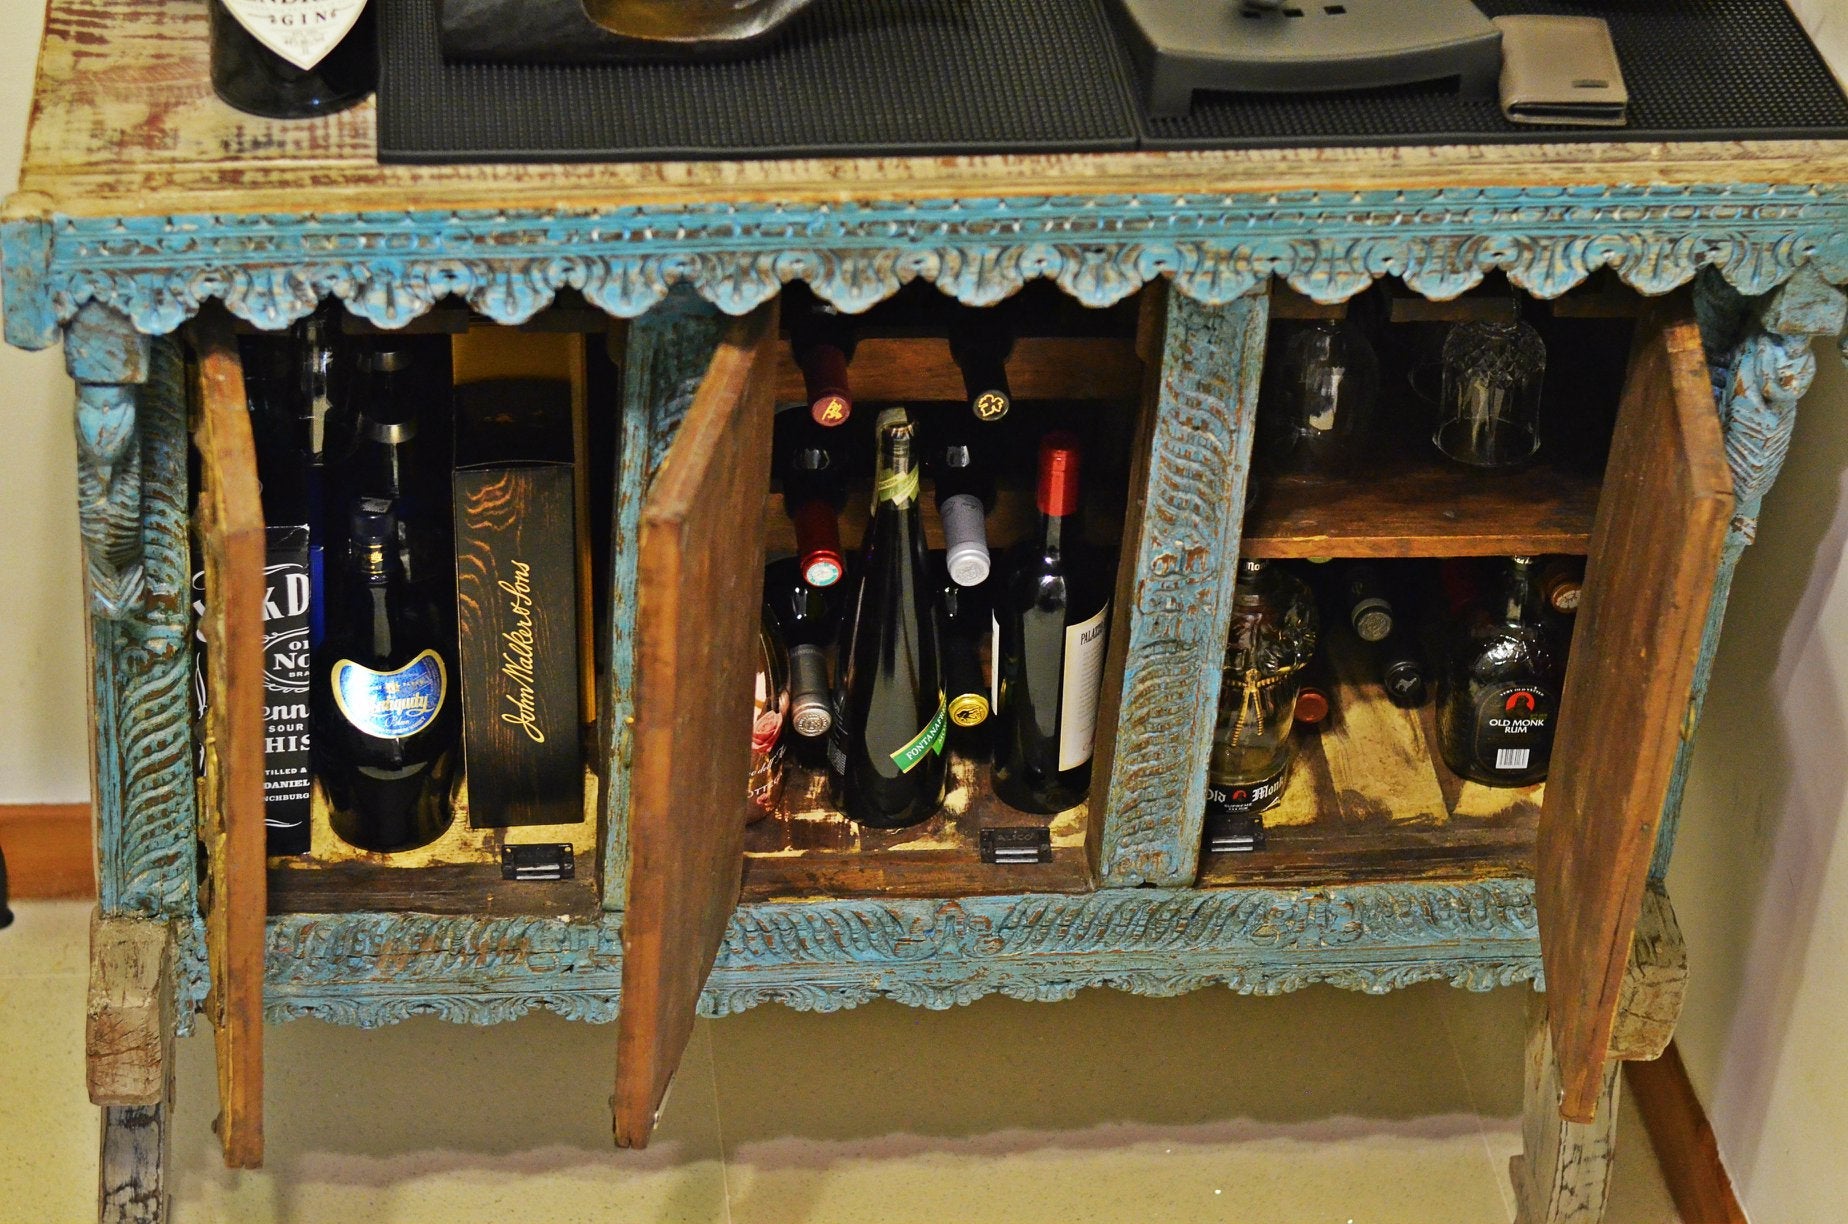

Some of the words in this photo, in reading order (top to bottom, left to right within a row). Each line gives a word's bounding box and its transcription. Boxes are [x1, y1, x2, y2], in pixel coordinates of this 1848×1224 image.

[281, 11, 326, 26] GIN
[498, 559, 533, 606] Sons
[502, 620, 534, 684] Walker
[501, 685, 545, 743] John
[268, 723, 304, 733] SOUR
[1489, 718, 1511, 727] OLD
[1512, 719, 1545, 728] MONK
[1504, 726, 1528, 734] RUM
